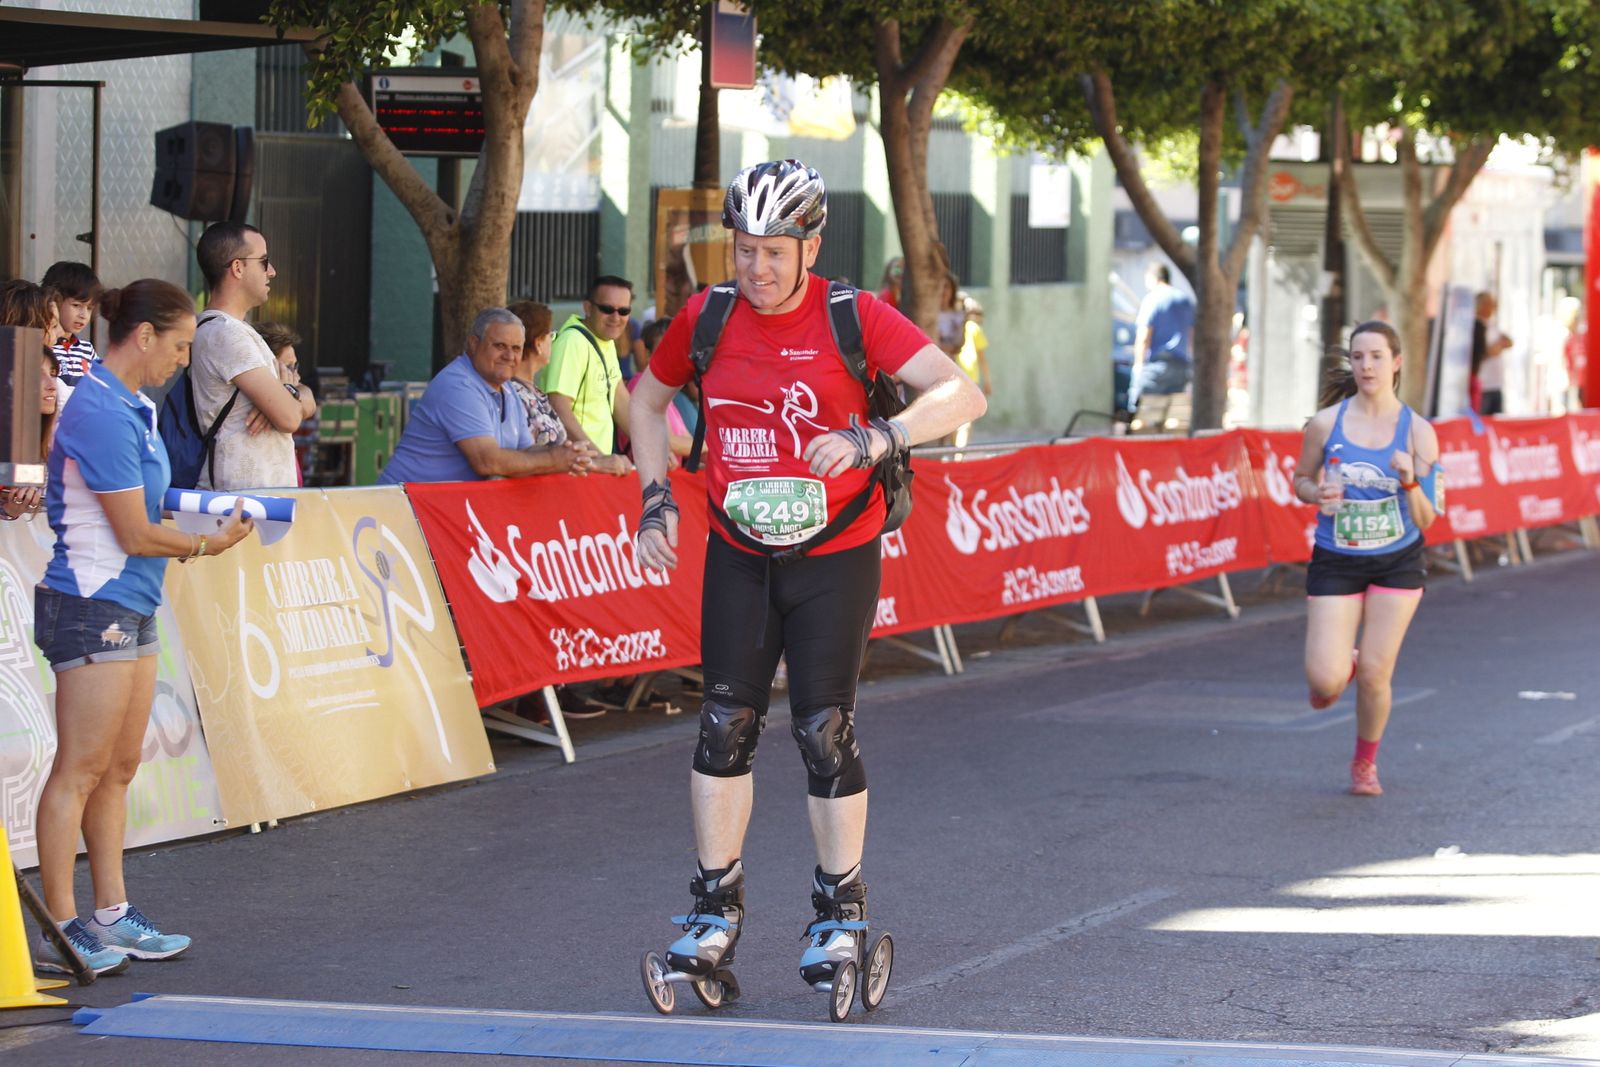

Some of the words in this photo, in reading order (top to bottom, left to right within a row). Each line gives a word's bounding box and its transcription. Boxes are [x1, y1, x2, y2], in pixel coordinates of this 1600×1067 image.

[719, 427, 776, 444] CARRERA
[745, 481, 755, 497] 6
[736, 501, 810, 524] 1249
[972, 476, 1090, 551] Santander
[1341, 514, 1392, 532] 1152
[506, 513, 672, 602] Santand
[263, 556, 360, 609] CARRERA
[238, 566, 281, 700] 6
